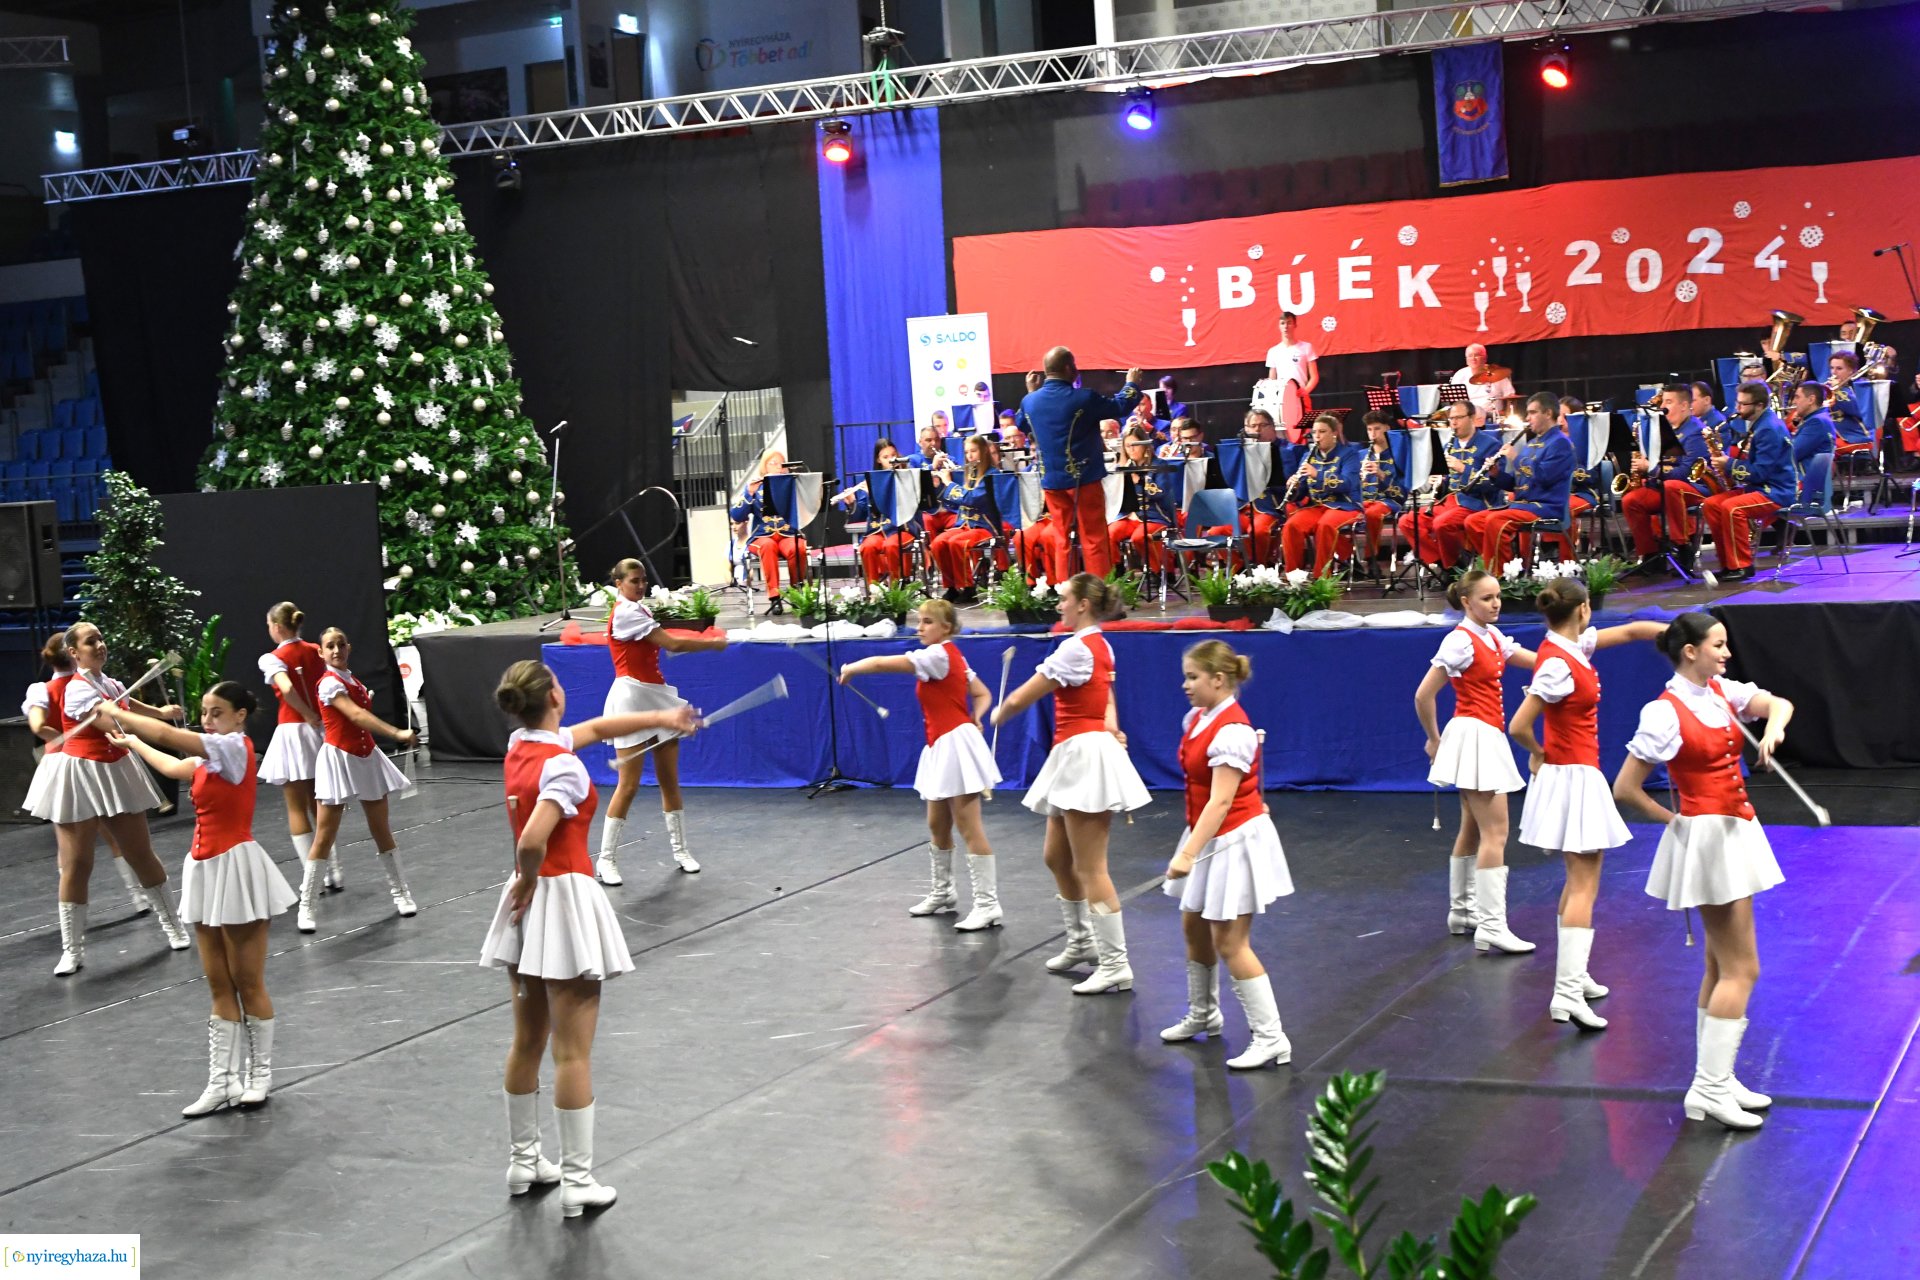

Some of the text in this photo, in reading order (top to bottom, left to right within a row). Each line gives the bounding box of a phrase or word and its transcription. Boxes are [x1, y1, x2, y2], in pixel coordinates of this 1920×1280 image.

[1216, 226, 1788, 317] BÚÉK 2024
[935, 331, 977, 344] SALDO
